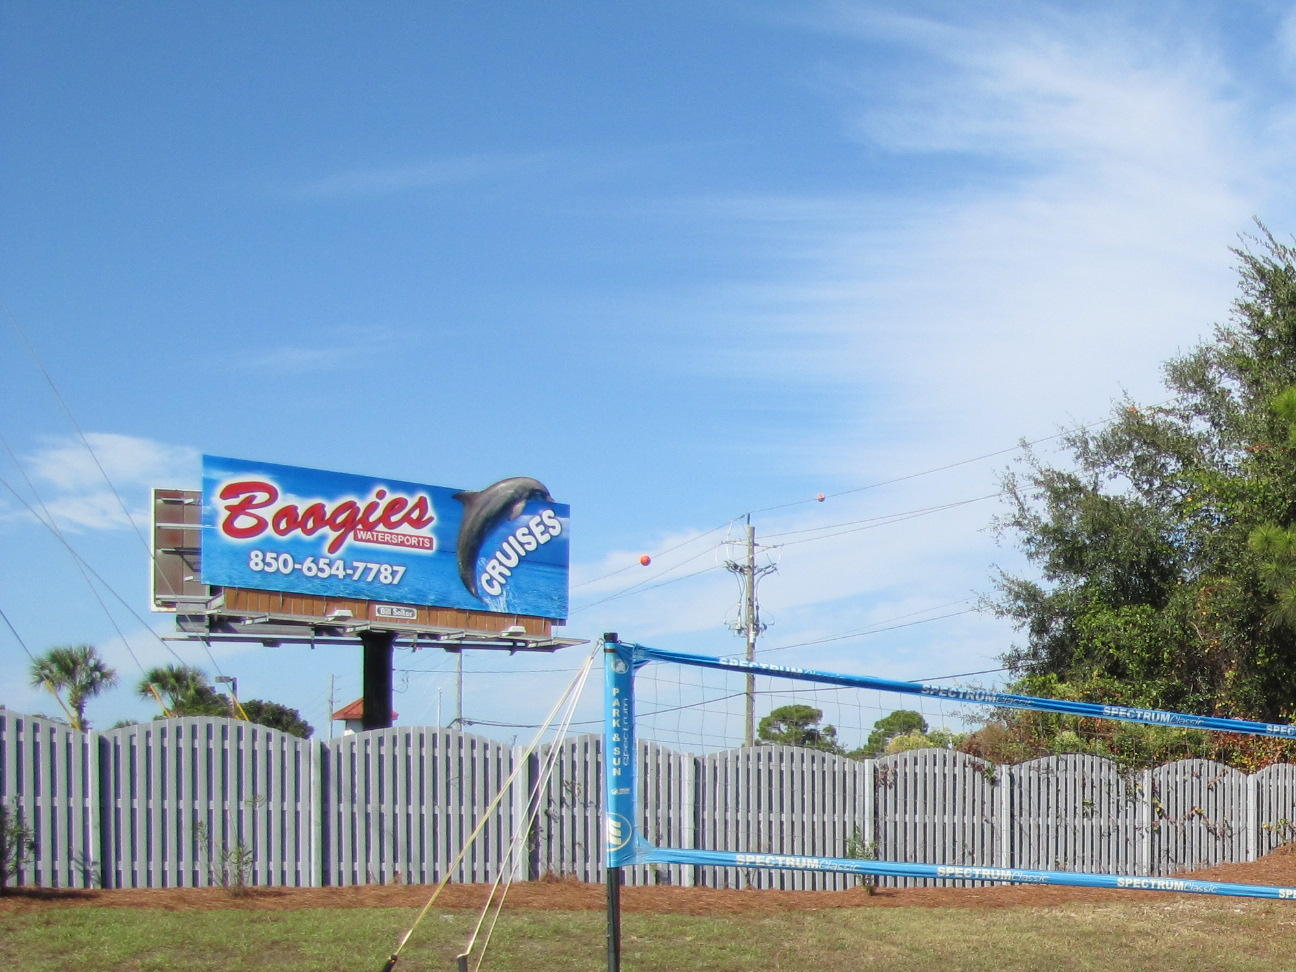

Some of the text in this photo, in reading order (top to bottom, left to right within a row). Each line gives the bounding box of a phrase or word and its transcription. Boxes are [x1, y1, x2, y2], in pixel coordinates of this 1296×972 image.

[219, 481, 434, 554] Boogies
[356, 530, 431, 548] WATERSPORTS
[248, 550, 406, 585] 850-654-7787
[481, 509, 562, 596] CRUISES
